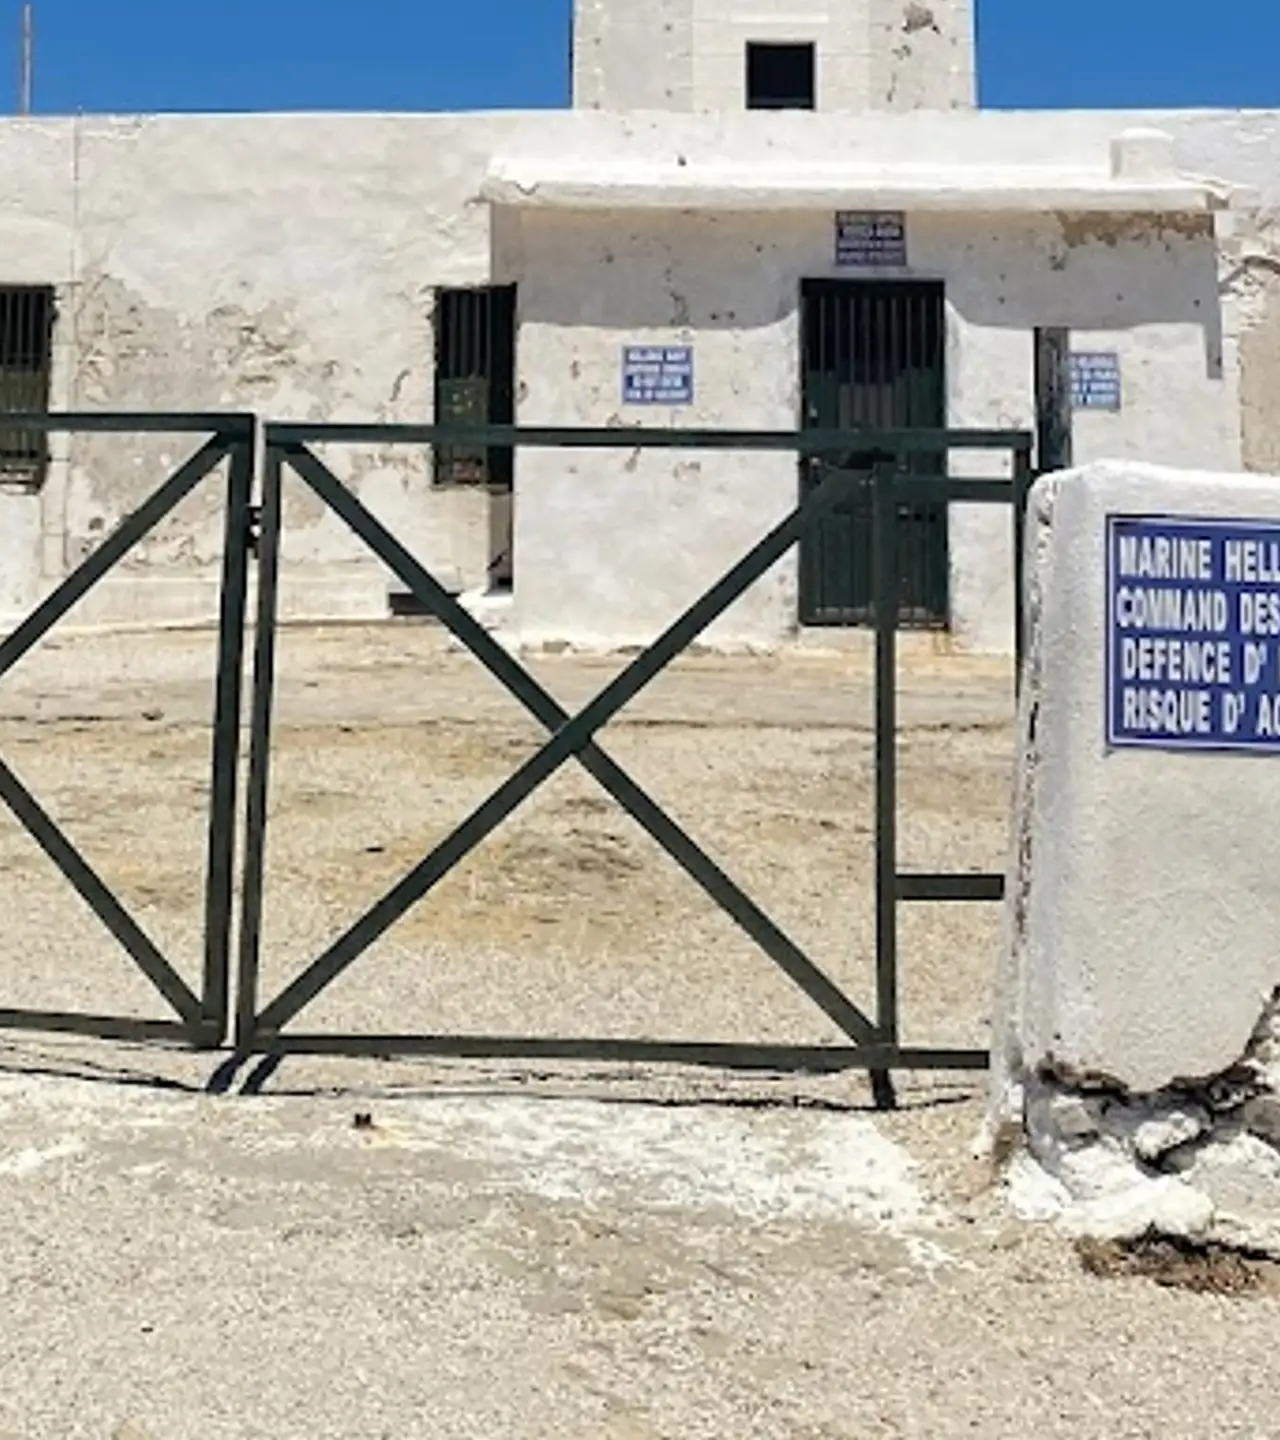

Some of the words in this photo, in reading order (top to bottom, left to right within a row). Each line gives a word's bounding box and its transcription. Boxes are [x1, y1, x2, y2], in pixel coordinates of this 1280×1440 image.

[1119, 536, 1211, 579] MARINE
[1117, 585, 1228, 632] COMMAND
[1122, 637, 1231, 683] DEFENCE
[1244, 642, 1267, 684] D'
[1123, 686, 1211, 733] RISQUE
[1224, 691, 1245, 733] D'
